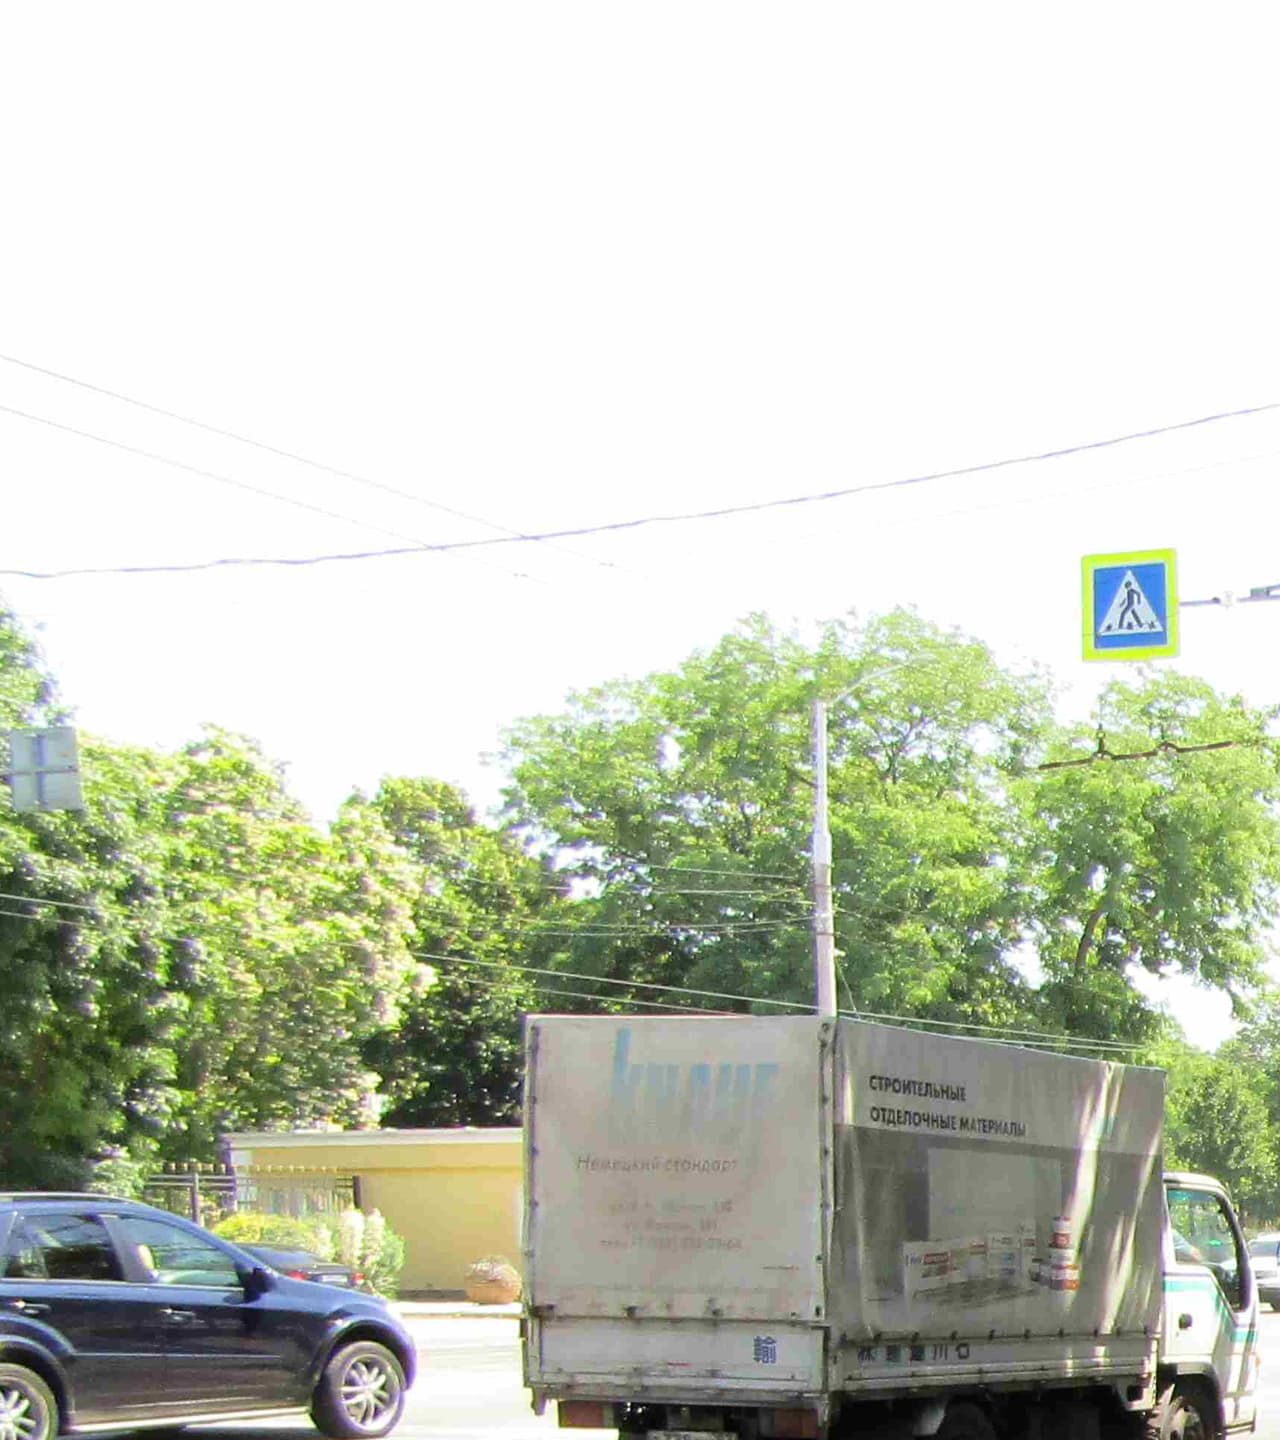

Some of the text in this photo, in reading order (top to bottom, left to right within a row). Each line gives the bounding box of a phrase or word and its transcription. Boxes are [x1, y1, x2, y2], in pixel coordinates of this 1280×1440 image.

[868, 1074, 967, 1102] СТРОИТЕЛЬНЫЕ
[869, 1105, 1027, 1137] ОТДЕЛОЧНЫЕ МАТЕРИАЛЫ
